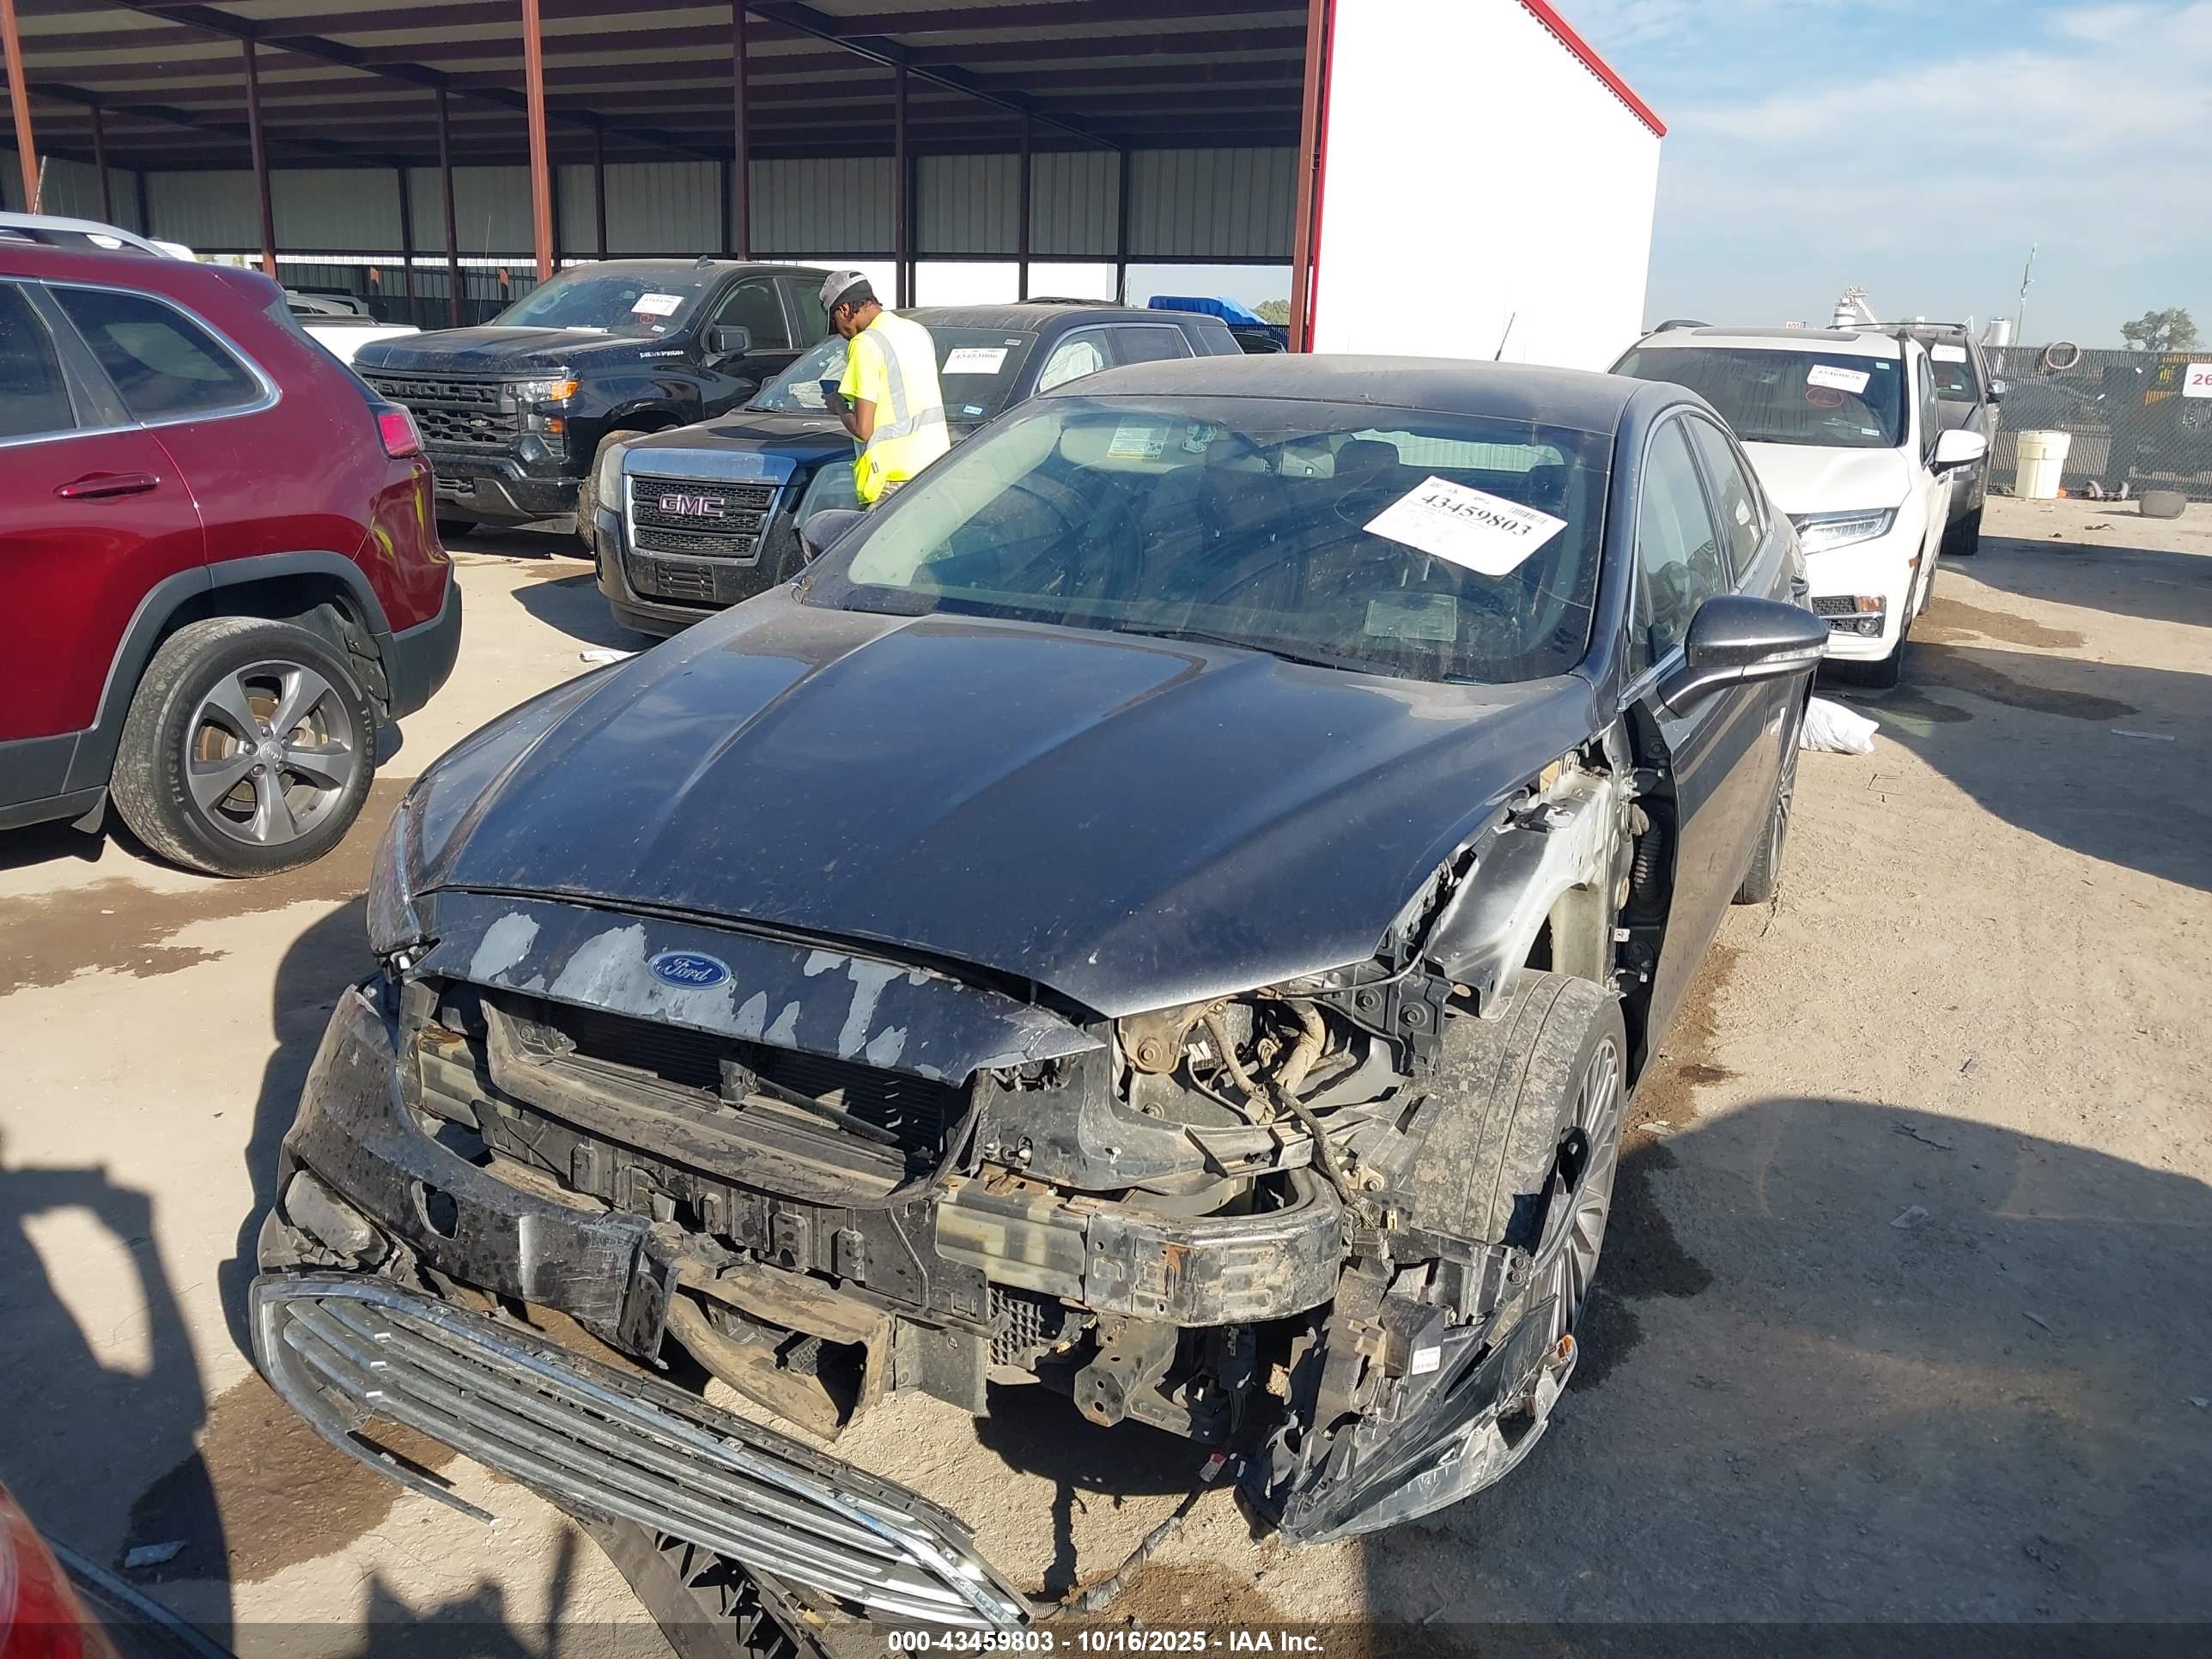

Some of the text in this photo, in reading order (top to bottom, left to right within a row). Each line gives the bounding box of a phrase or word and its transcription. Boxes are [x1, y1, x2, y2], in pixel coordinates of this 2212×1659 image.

[659, 493, 725, 517] GMC
[1421, 494, 1533, 536] 43459803
[664, 957, 714, 981] Ford
